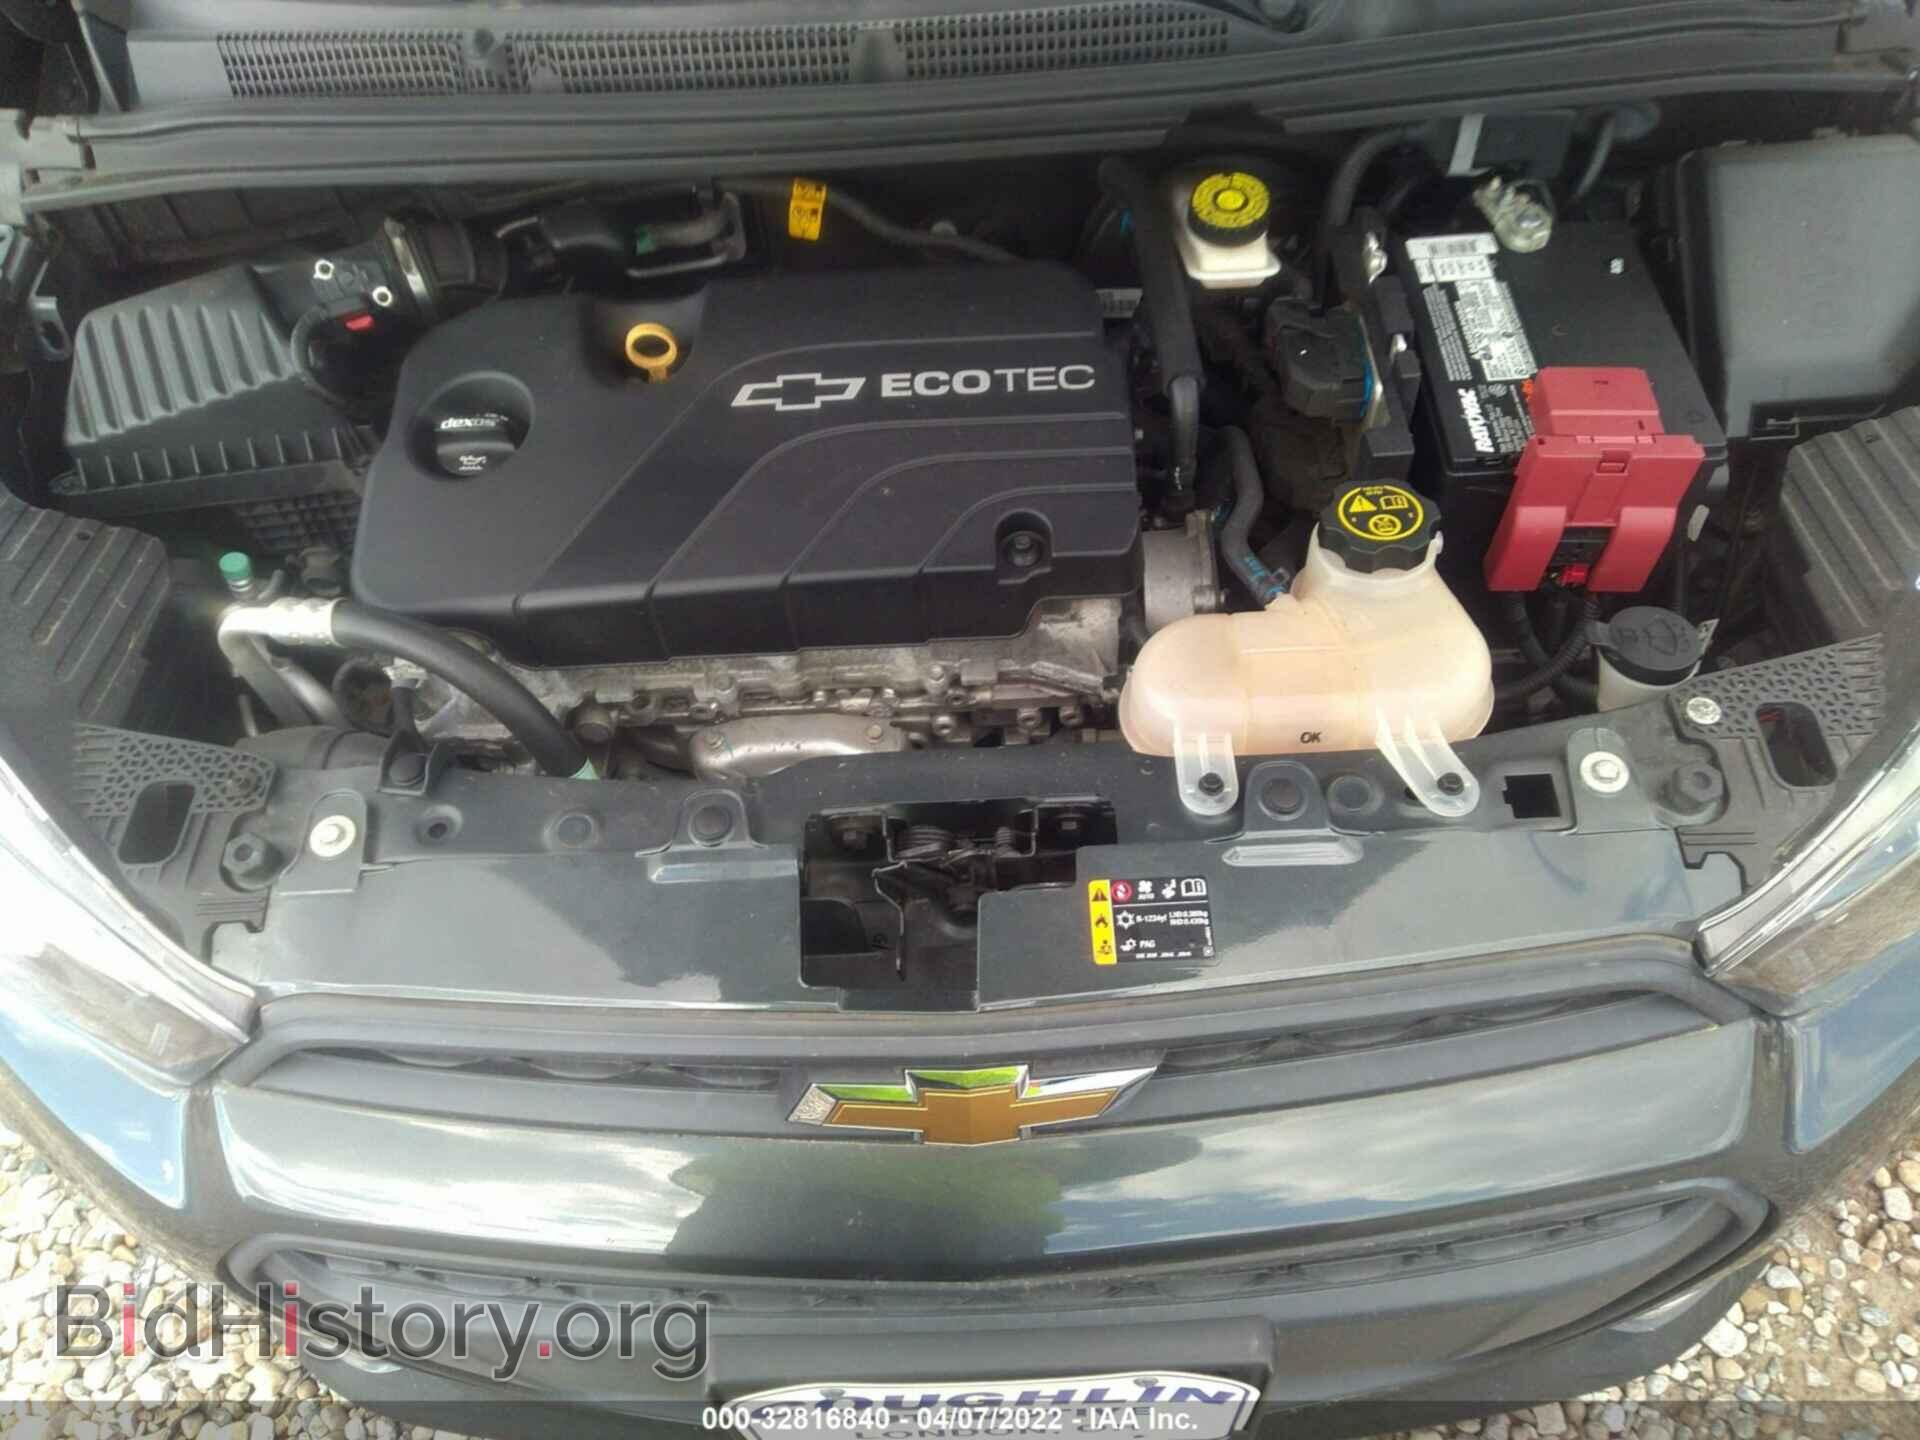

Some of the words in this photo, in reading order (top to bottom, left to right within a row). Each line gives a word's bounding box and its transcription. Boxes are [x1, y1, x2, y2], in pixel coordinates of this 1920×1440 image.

[881, 364, 1096, 398] ECOTEC
[440, 417, 496, 429] dexos
[1457, 387, 1496, 453] RAYOVAC
[1300, 731, 1322, 744] OK
